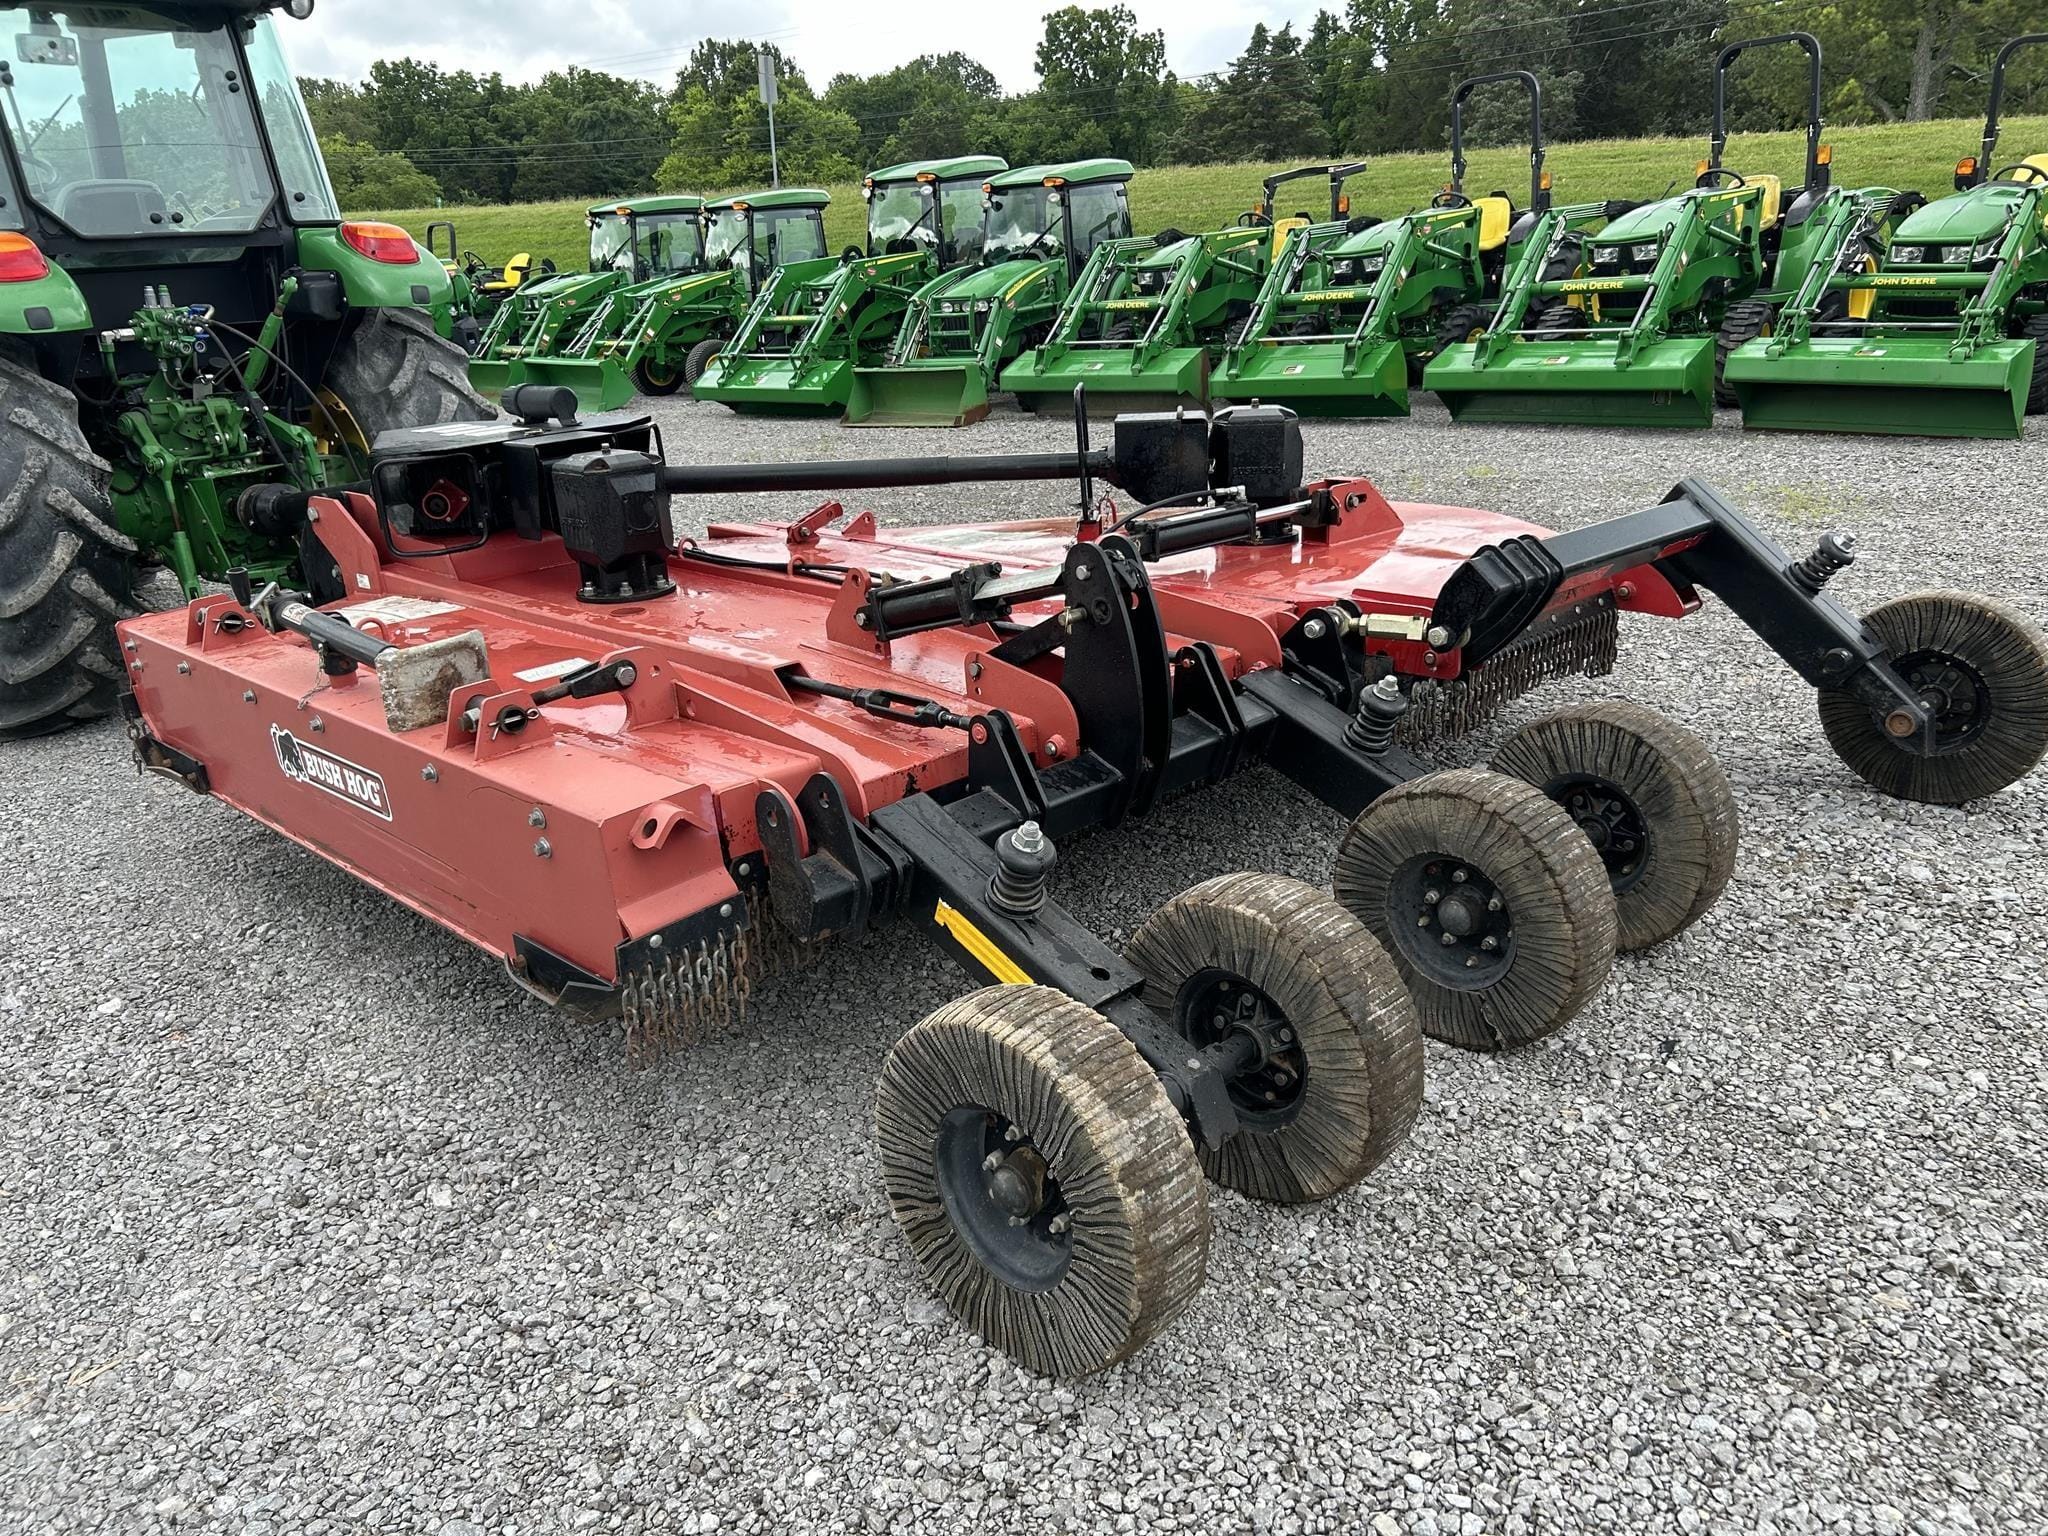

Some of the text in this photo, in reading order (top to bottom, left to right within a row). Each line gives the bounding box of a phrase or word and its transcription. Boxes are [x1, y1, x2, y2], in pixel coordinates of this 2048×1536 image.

[1560, 281, 1624, 291] JOHN DEERE
[1870, 277, 1937, 285] JOHN DEERE
[1302, 291, 1355, 301] JOHN DEERE
[302, 751, 345, 791] BUSH
